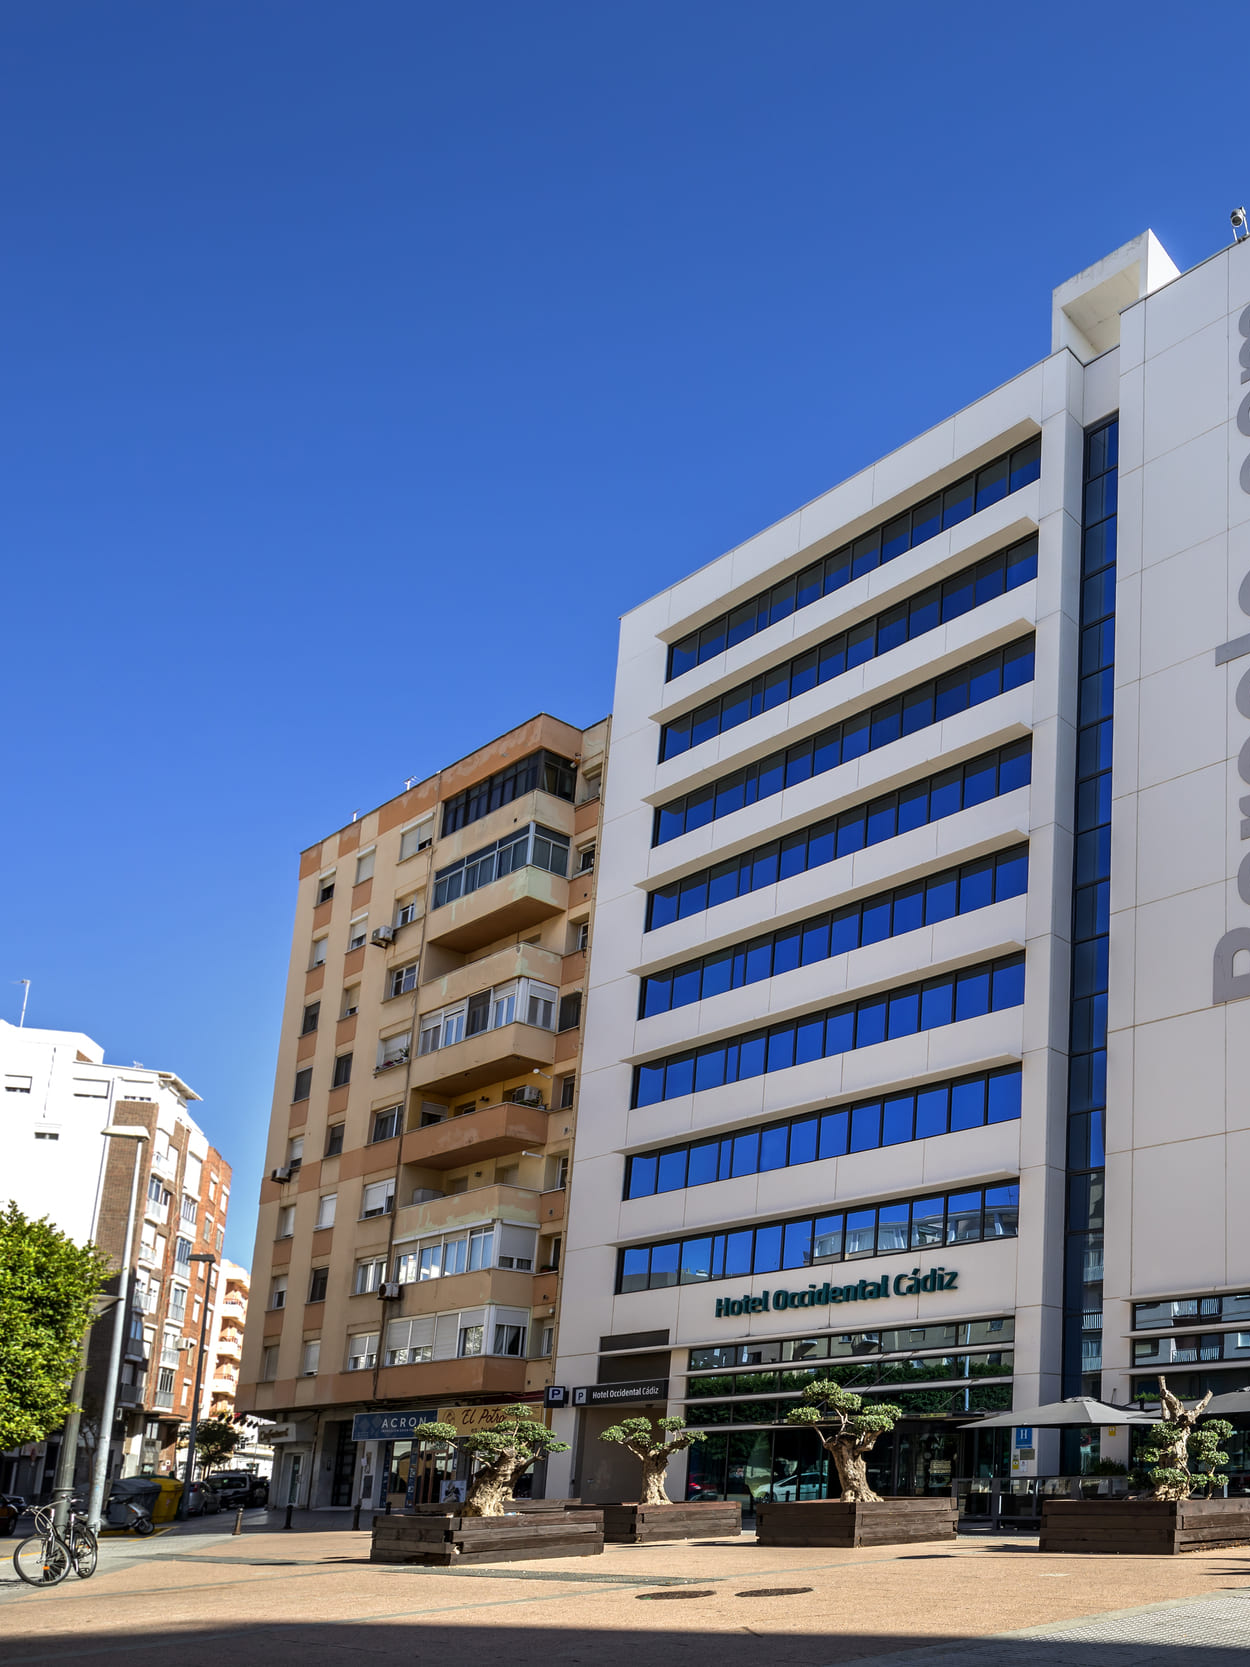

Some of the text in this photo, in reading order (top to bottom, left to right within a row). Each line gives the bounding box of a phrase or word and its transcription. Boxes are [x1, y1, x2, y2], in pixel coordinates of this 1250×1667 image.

[715, 1267, 958, 1318] Hotel Occidental Cádiz
[551, 1389, 561, 1399] P
[578, 1386, 659, 1400] P Hotel Occidental Cádiz
[381, 1416, 427, 1429] ACRON
[462, 1408, 476, 1425] El
